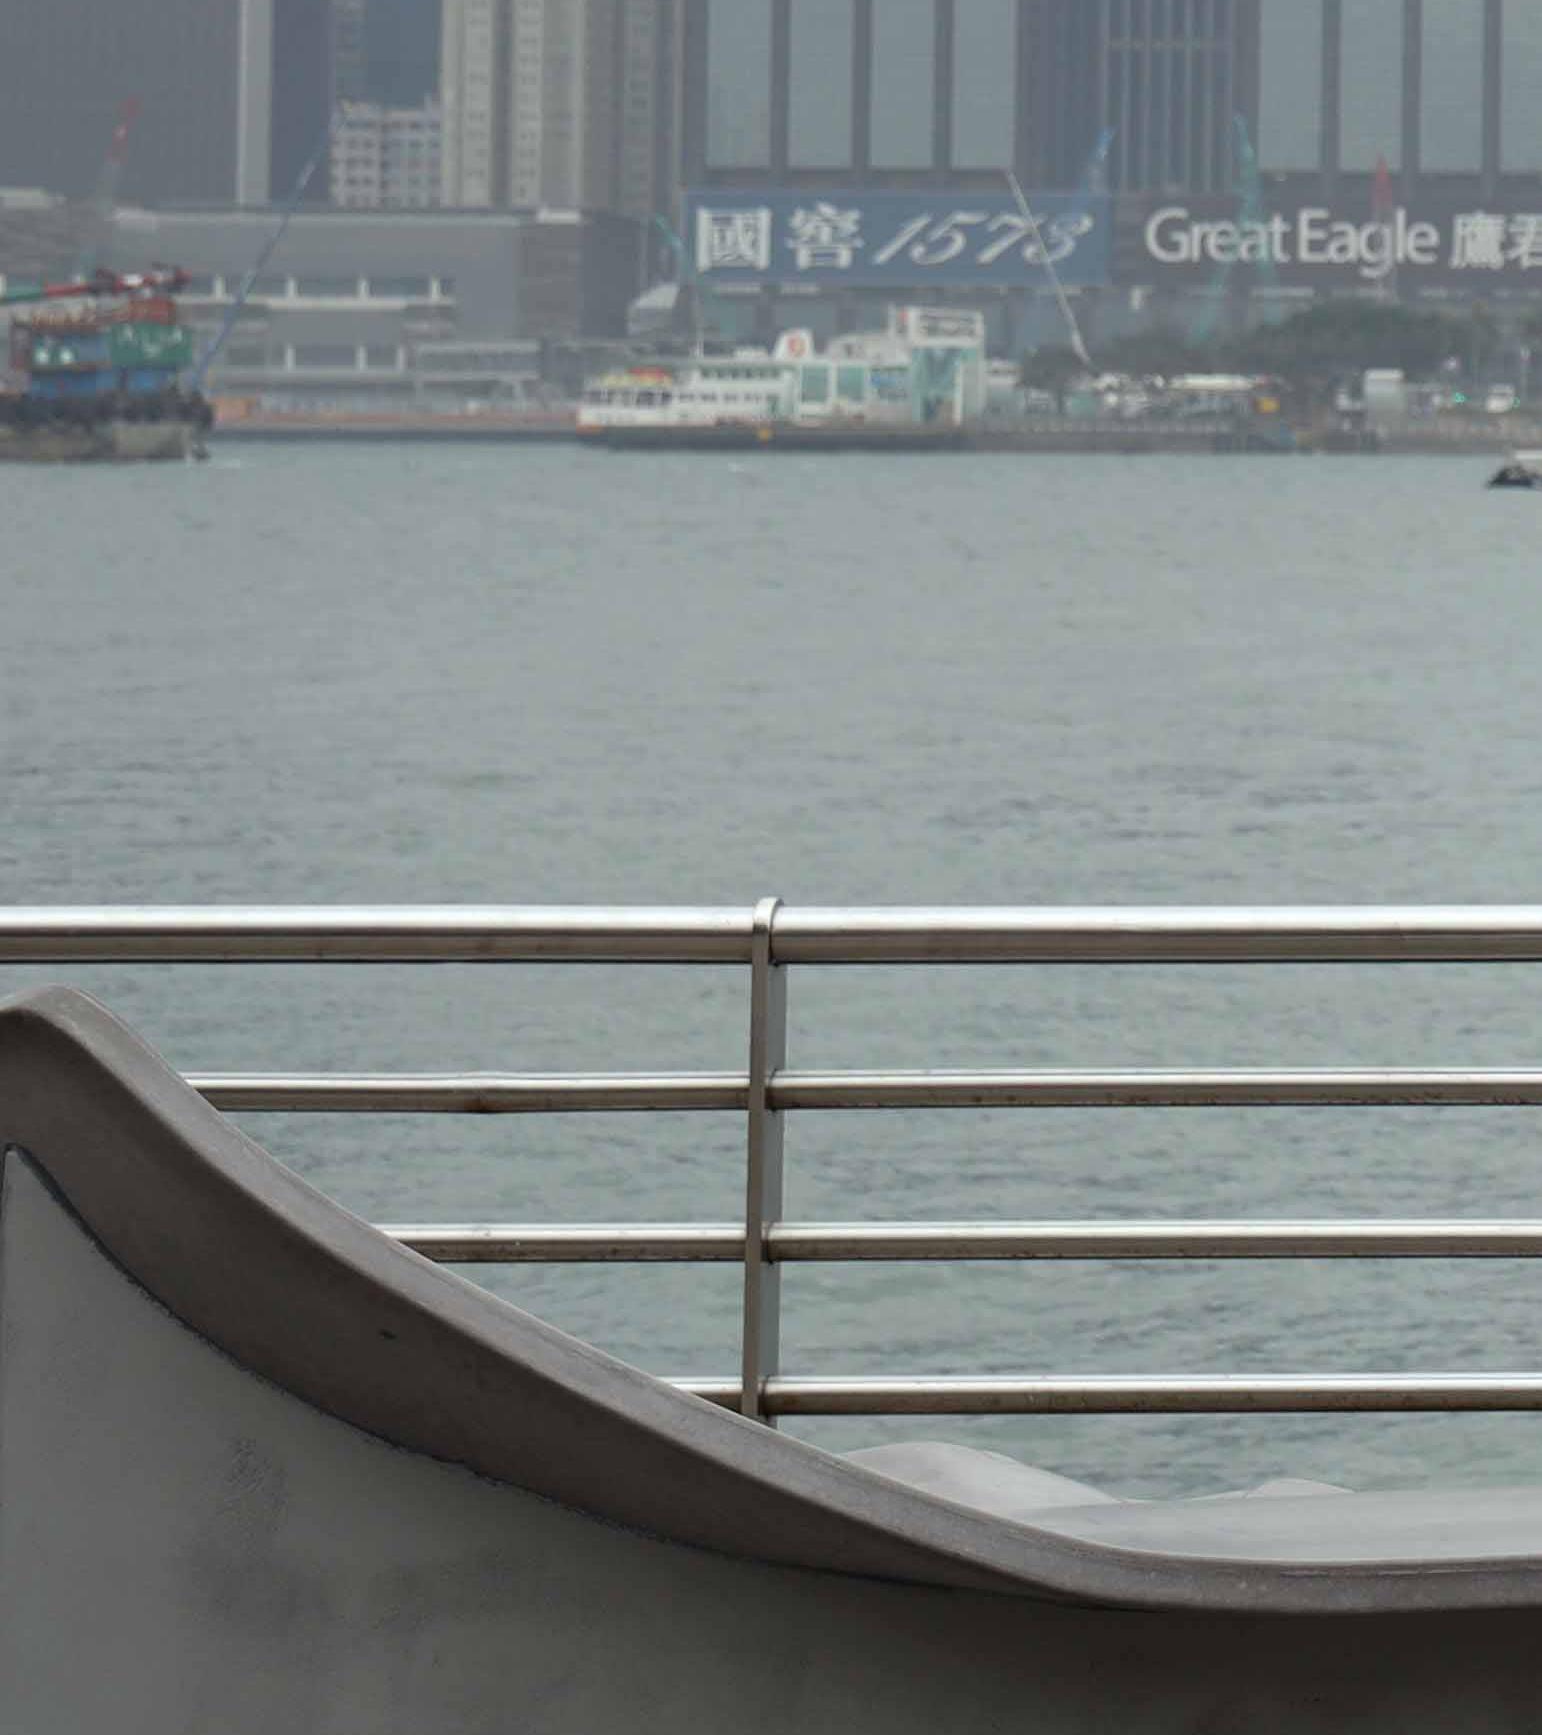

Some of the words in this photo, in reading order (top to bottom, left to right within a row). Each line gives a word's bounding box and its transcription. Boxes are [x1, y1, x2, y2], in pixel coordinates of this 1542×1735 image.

[873, 208, 1095, 266] 1573
[1145, 207, 1293, 265] Great
[1298, 207, 1441, 278] Eagle
